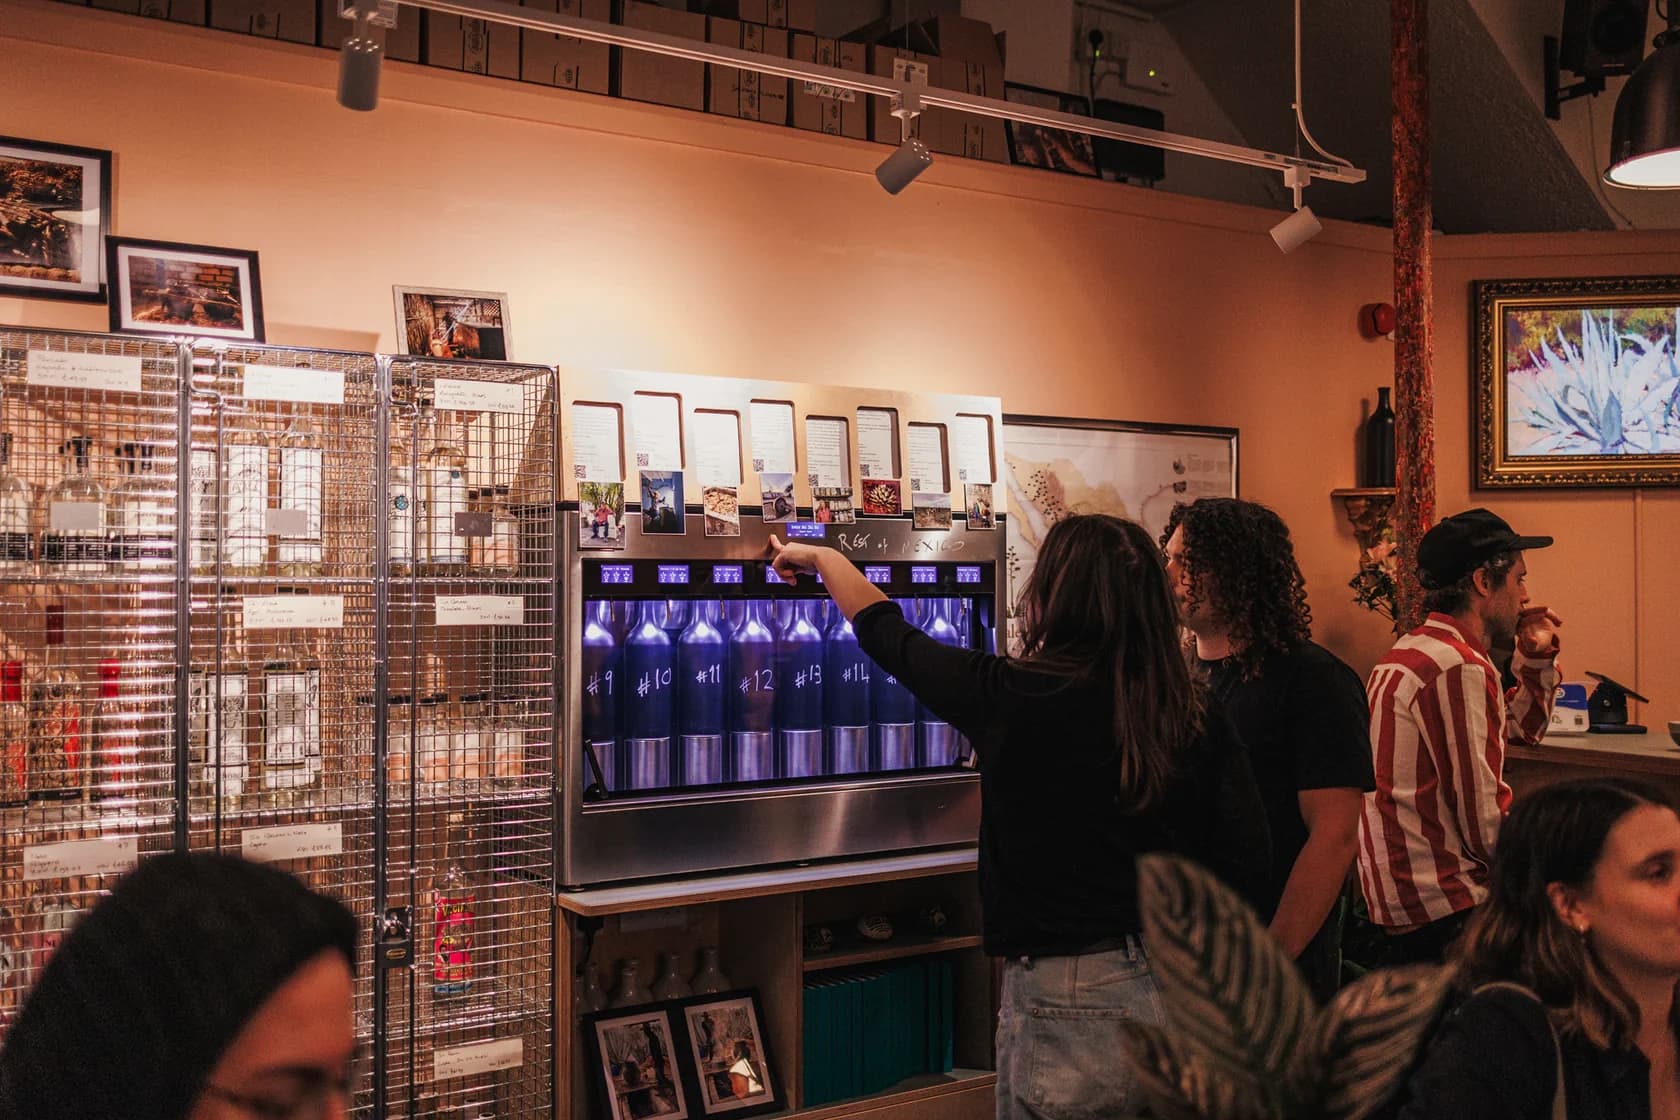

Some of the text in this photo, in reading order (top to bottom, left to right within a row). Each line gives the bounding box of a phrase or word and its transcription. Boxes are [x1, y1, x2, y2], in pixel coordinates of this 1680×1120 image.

[838, 533, 871, 552] REST
[586, 670, 613, 696] #9
[637, 667, 672, 697] #10
[696, 664, 720, 683] #11
[739, 669, 774, 694] #12
[794, 664, 822, 688] #13
[842, 663, 870, 684] #14
